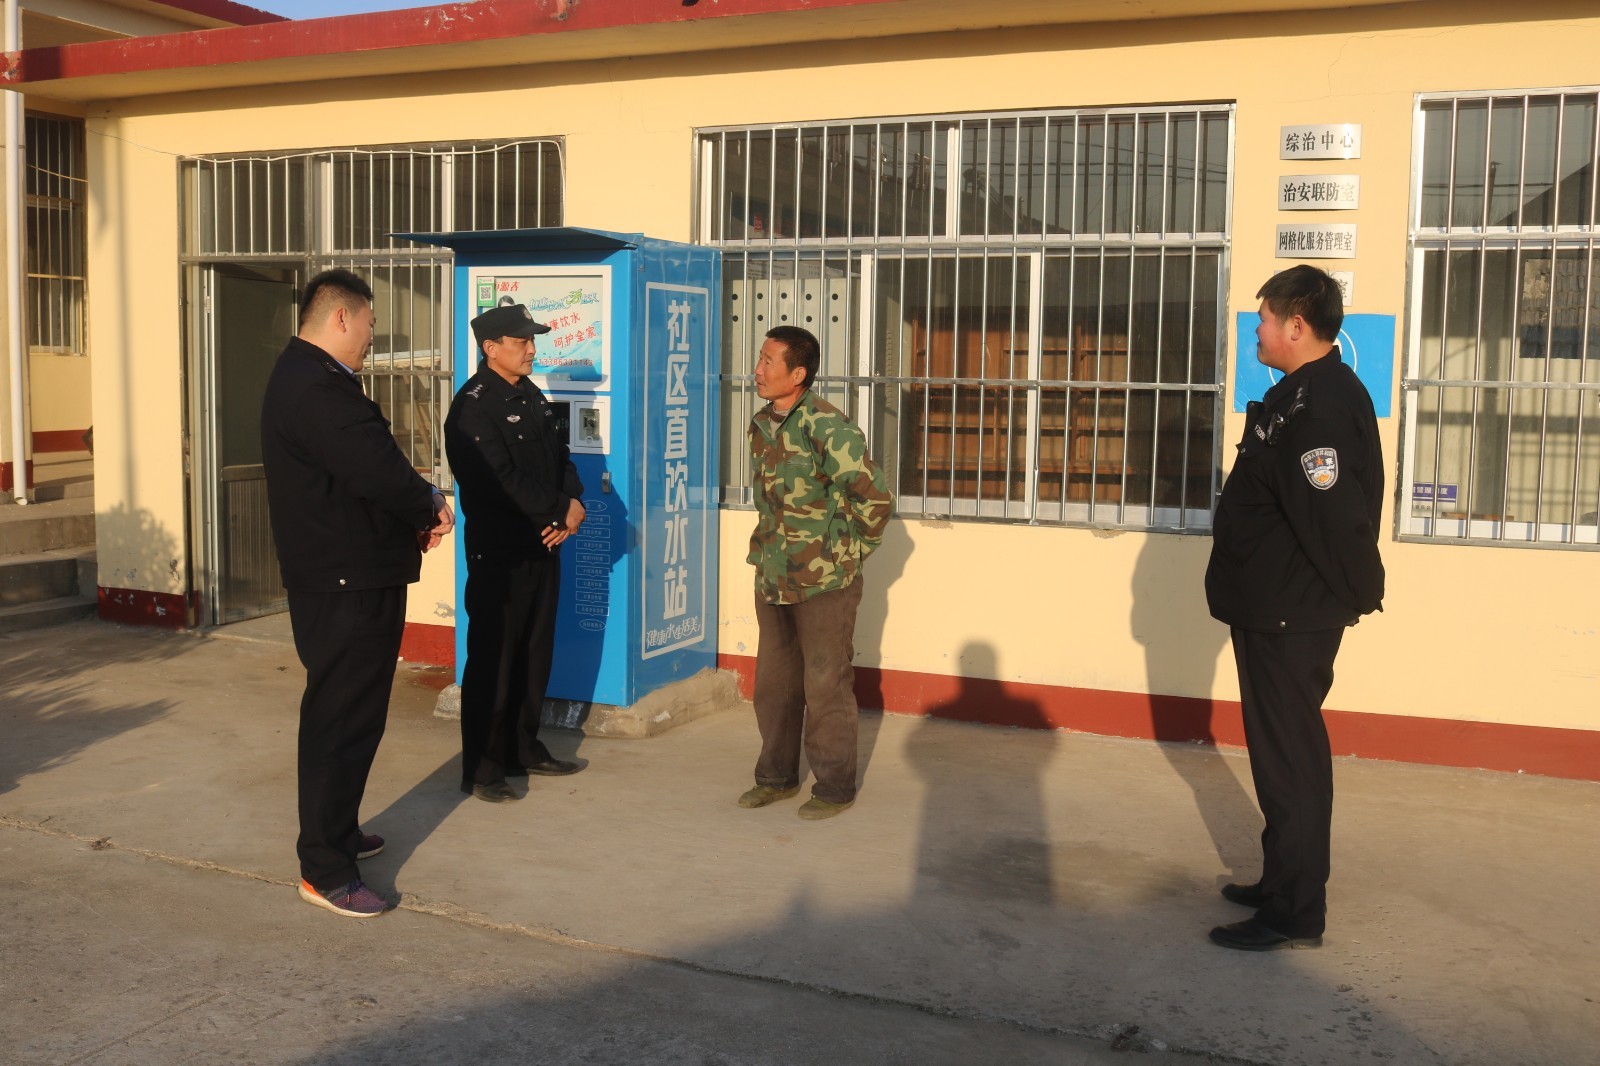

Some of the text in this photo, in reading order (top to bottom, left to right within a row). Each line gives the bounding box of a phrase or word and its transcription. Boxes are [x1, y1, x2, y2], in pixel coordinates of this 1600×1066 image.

[1285, 130, 1354, 152] 综治中心
[1283, 181, 1355, 202] 治安联防室
[1279, 230, 1353, 251] 网格化服务管理室
[543, 312, 580, 331] 康饮水
[663, 299, 691, 620] 社区直饮水站
